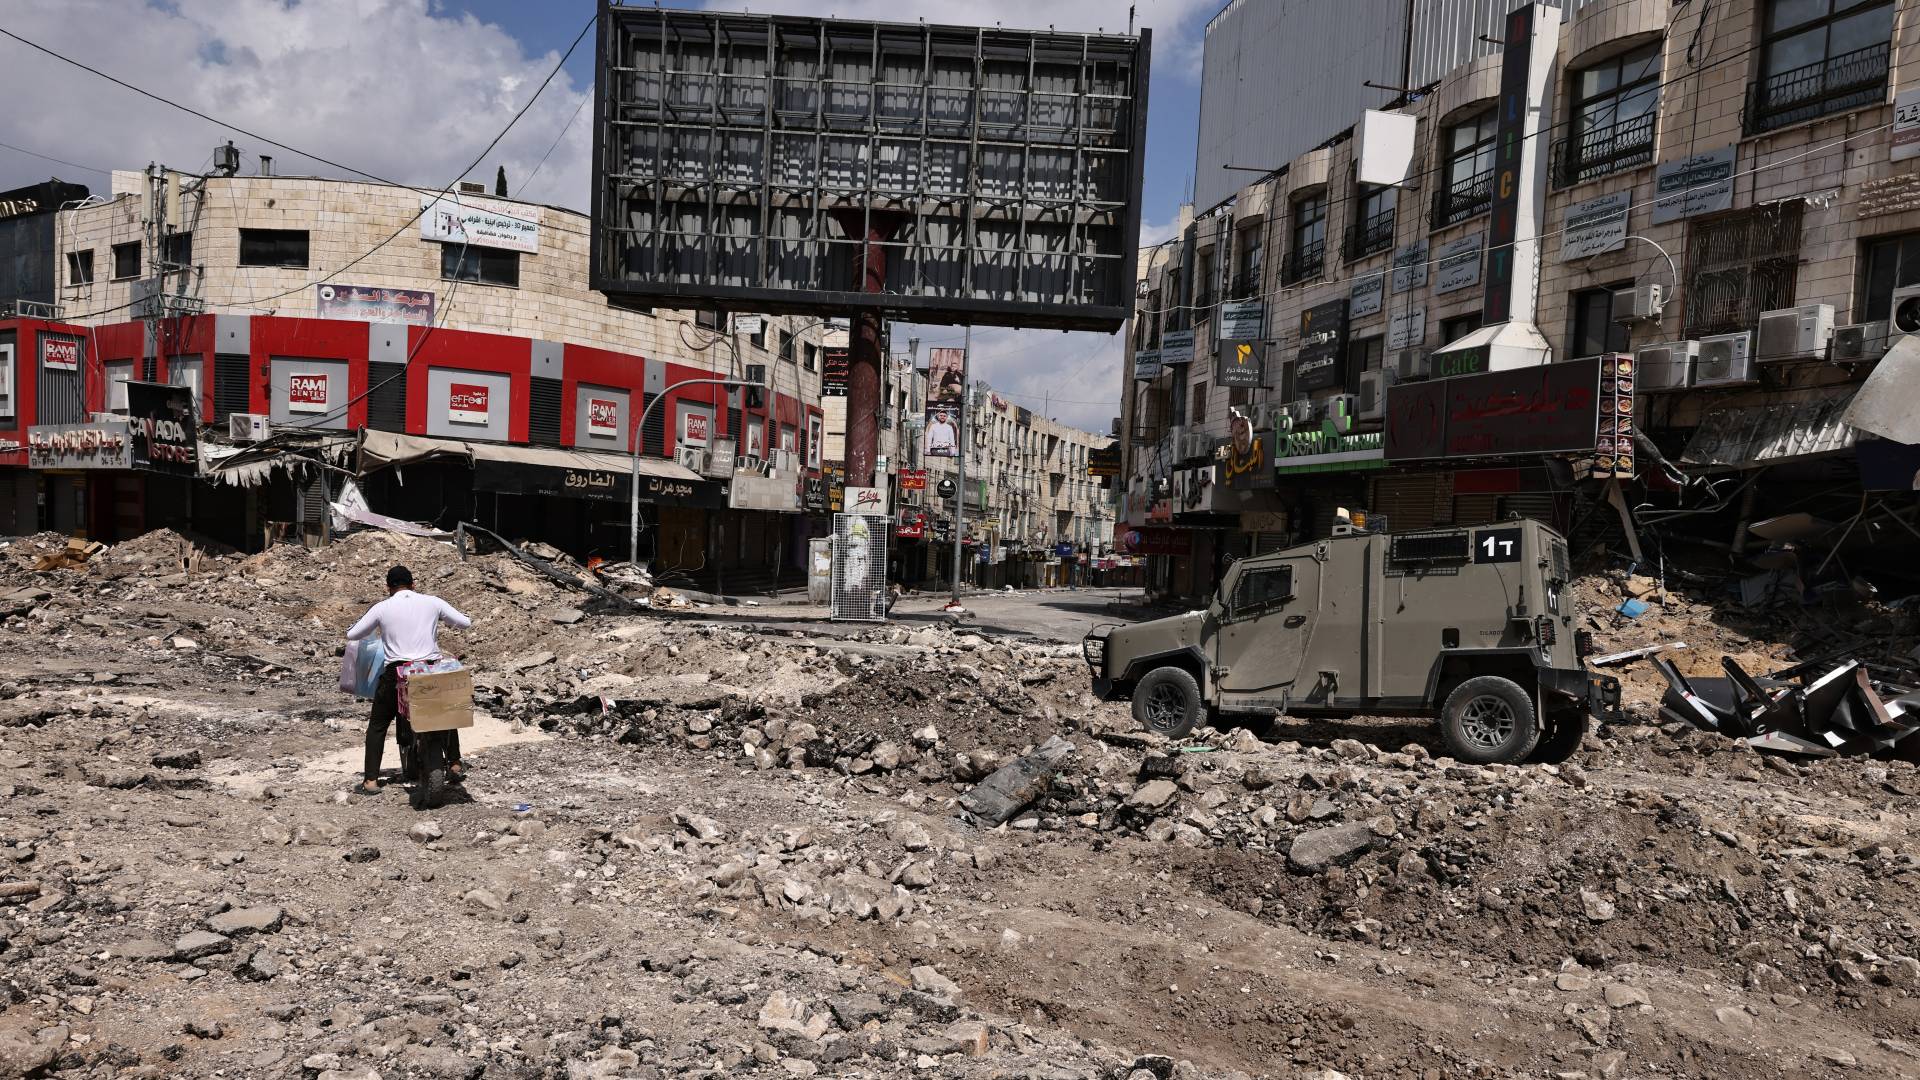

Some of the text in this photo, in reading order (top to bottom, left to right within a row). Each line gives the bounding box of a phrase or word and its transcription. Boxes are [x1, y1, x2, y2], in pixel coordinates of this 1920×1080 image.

[1581, 196, 1618, 211] الدكتورة
[382, 290, 430, 307] شركة
[47, 343, 76, 355] RAMI
[1440, 351, 1480, 376] Café
[291, 378, 326, 391] RAMI
[291, 390, 326, 398] CENTER
[592, 404, 616, 416] RAMI
[128, 412, 187, 443] CANADA
[688, 418, 707, 430] RAMI
[1276, 415, 1325, 457] BISSAN
[152, 443, 196, 464] STORE
[564, 469, 693, 497] مجوهرات الفاروق
[857, 489, 880, 509] Sky
